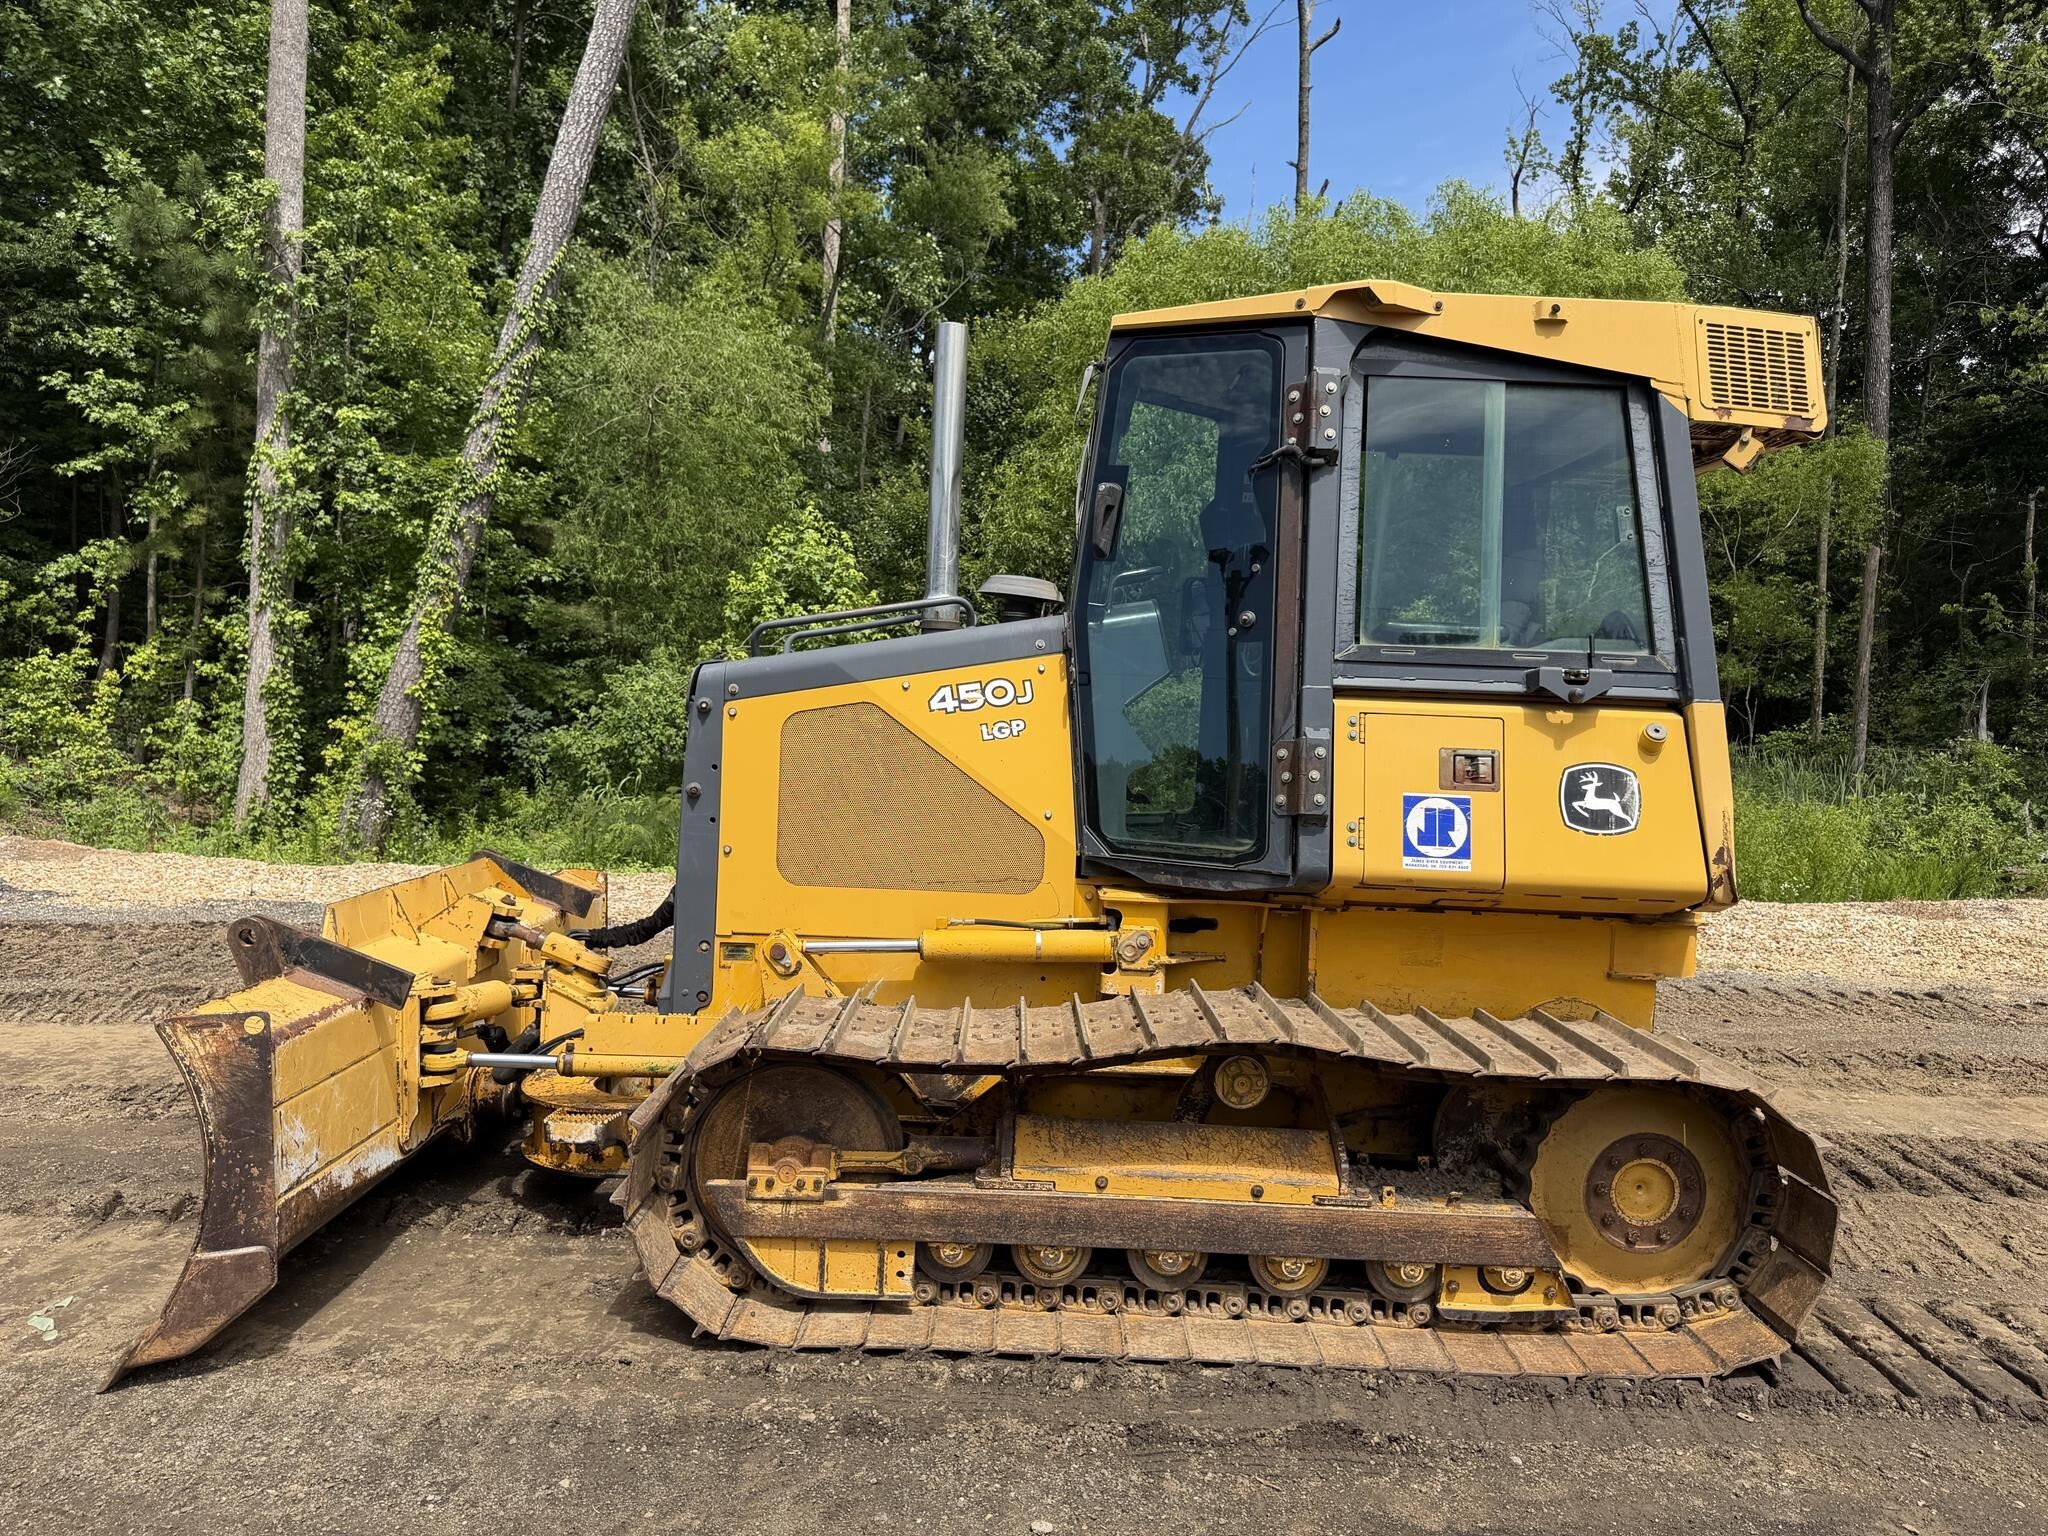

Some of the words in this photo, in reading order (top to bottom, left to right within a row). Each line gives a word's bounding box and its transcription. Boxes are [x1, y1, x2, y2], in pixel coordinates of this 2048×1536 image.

[928, 678, 1034, 714] 450J
[980, 719, 1026, 741] LGP
[1417, 807, 1457, 848] JR
